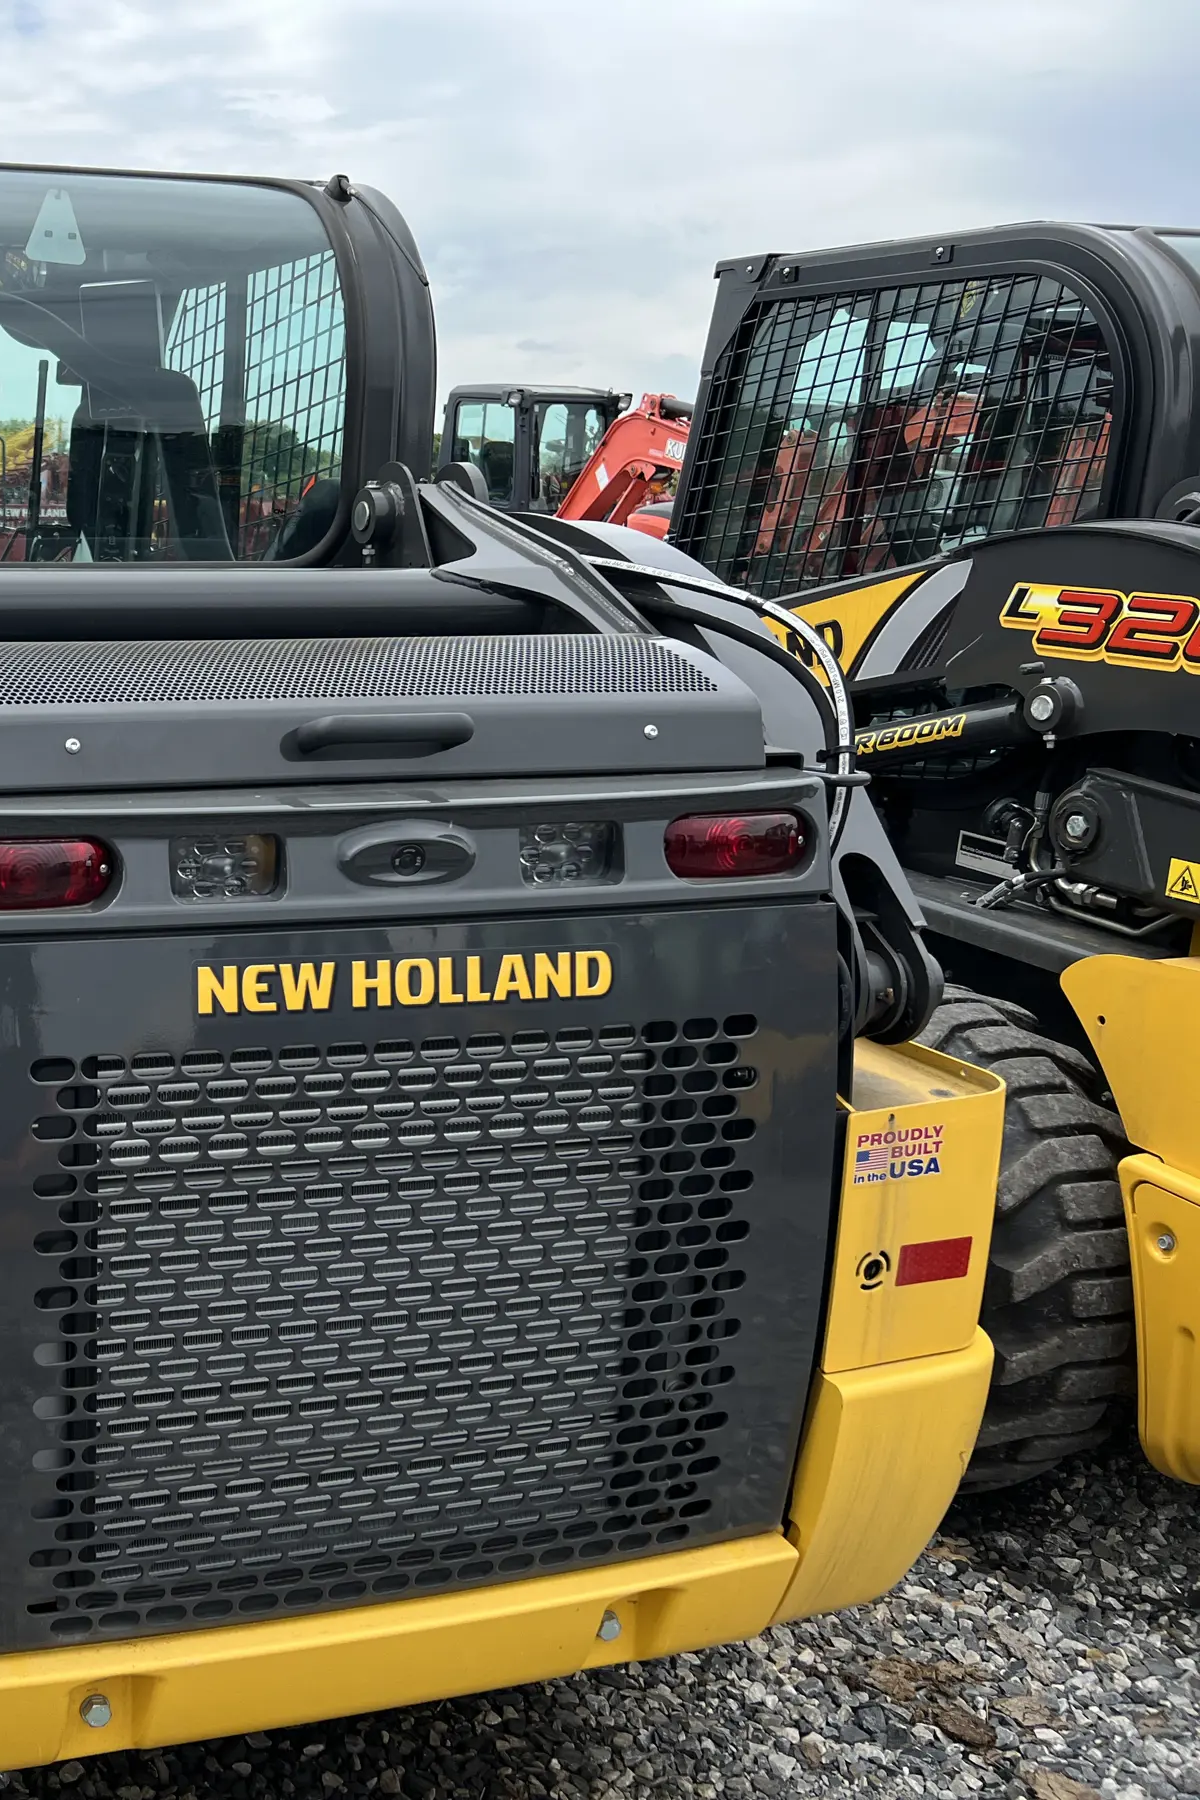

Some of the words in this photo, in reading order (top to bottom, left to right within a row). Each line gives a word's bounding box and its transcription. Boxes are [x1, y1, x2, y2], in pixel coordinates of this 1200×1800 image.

[665, 438, 687, 462] KU
[21, 508, 68, 517] HLAND
[1000, 582, 1200, 676] L32
[876, 714, 966, 751] BOOM
[197, 961, 335, 1014] NEW
[351, 950, 613, 1009] HOLLAND
[857, 1125, 944, 1148] PROUDLY
[890, 1141, 943, 1159] BUILT
[853, 1175, 865, 1184] in
[867, 1172, 887, 1184] the
[889, 1157, 940, 1180] USA
